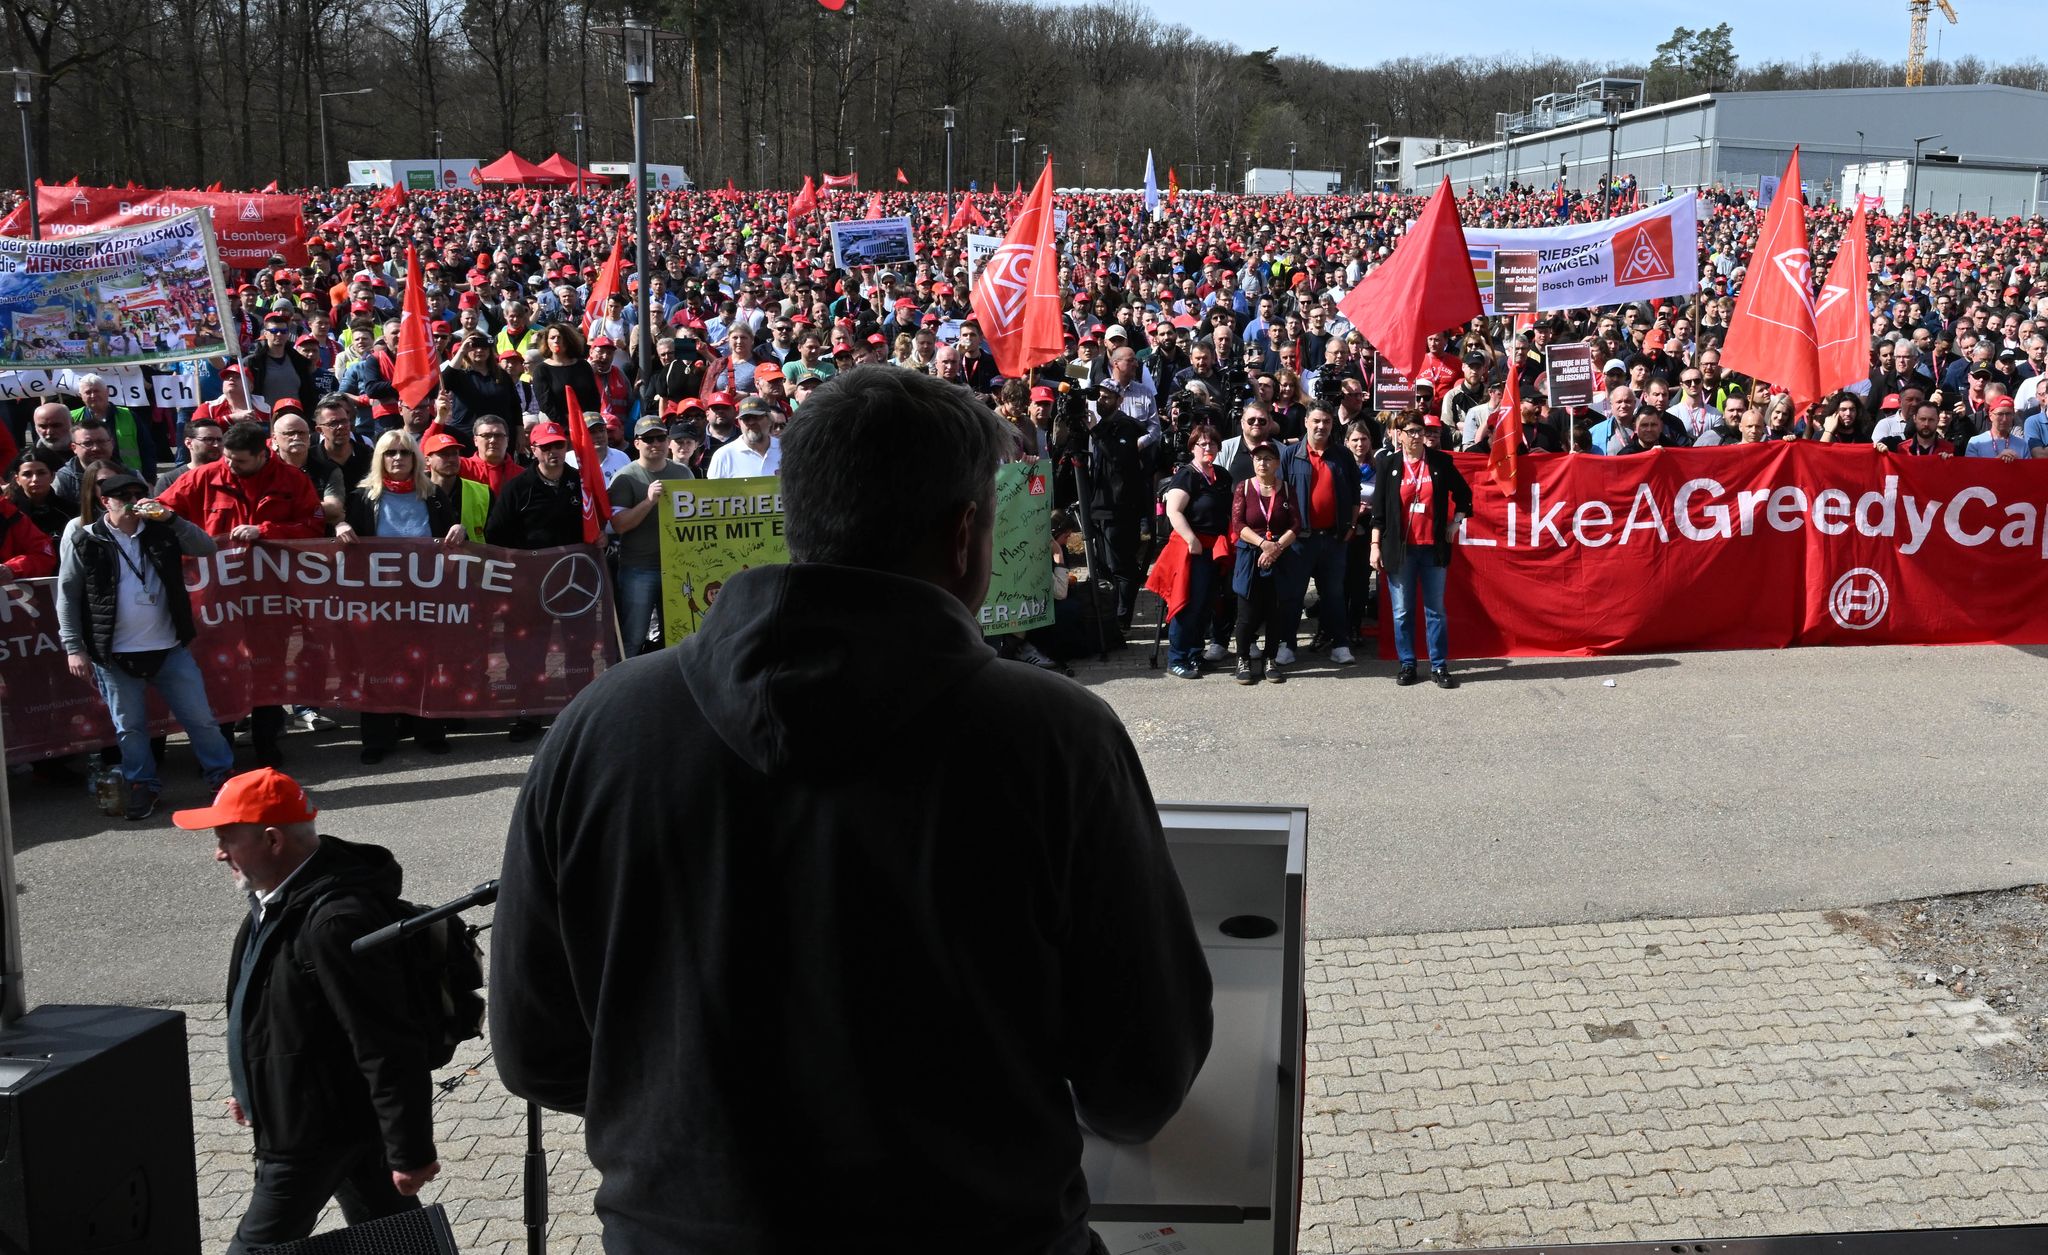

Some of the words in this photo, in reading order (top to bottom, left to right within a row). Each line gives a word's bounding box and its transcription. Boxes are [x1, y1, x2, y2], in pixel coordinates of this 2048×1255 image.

[119, 201, 216, 219] Betriebst
[51, 223, 95, 235] WORK
[222, 229, 287, 244] Leonberg
[28, 241, 65, 255] stirbt
[68, 241, 91, 256] der
[95, 222, 194, 255] KAPITALISMUS
[218, 246, 278, 259] Germany
[25, 251, 136, 274] MENSCHHEIT!
[1500, 266, 1511, 274] Der
[1511, 266, 1527, 274] Markt
[1527, 266, 1537, 274] hat
[64, 283, 79, 292] aus
[80, 279, 94, 288] der
[1542, 278, 1574, 291] Bosch
[1577, 274, 1609, 287] GmbH
[1381, 366, 1393, 375] Wer
[1552, 359, 1575, 368] BETRIEBE
[1580, 358, 1590, 366] DIE
[1562, 366, 1579, 374] HÄNDE
[1579, 365, 1590, 373] DER
[675, 524, 718, 543] WIR
[725, 521, 764, 539] MIT
[0, 580, 60, 623] RT
[185, 546, 516, 593] UENSLEUTE
[0, 632, 59, 660] STA
[201, 595, 469, 625] UNTERTÜRKHEIM
